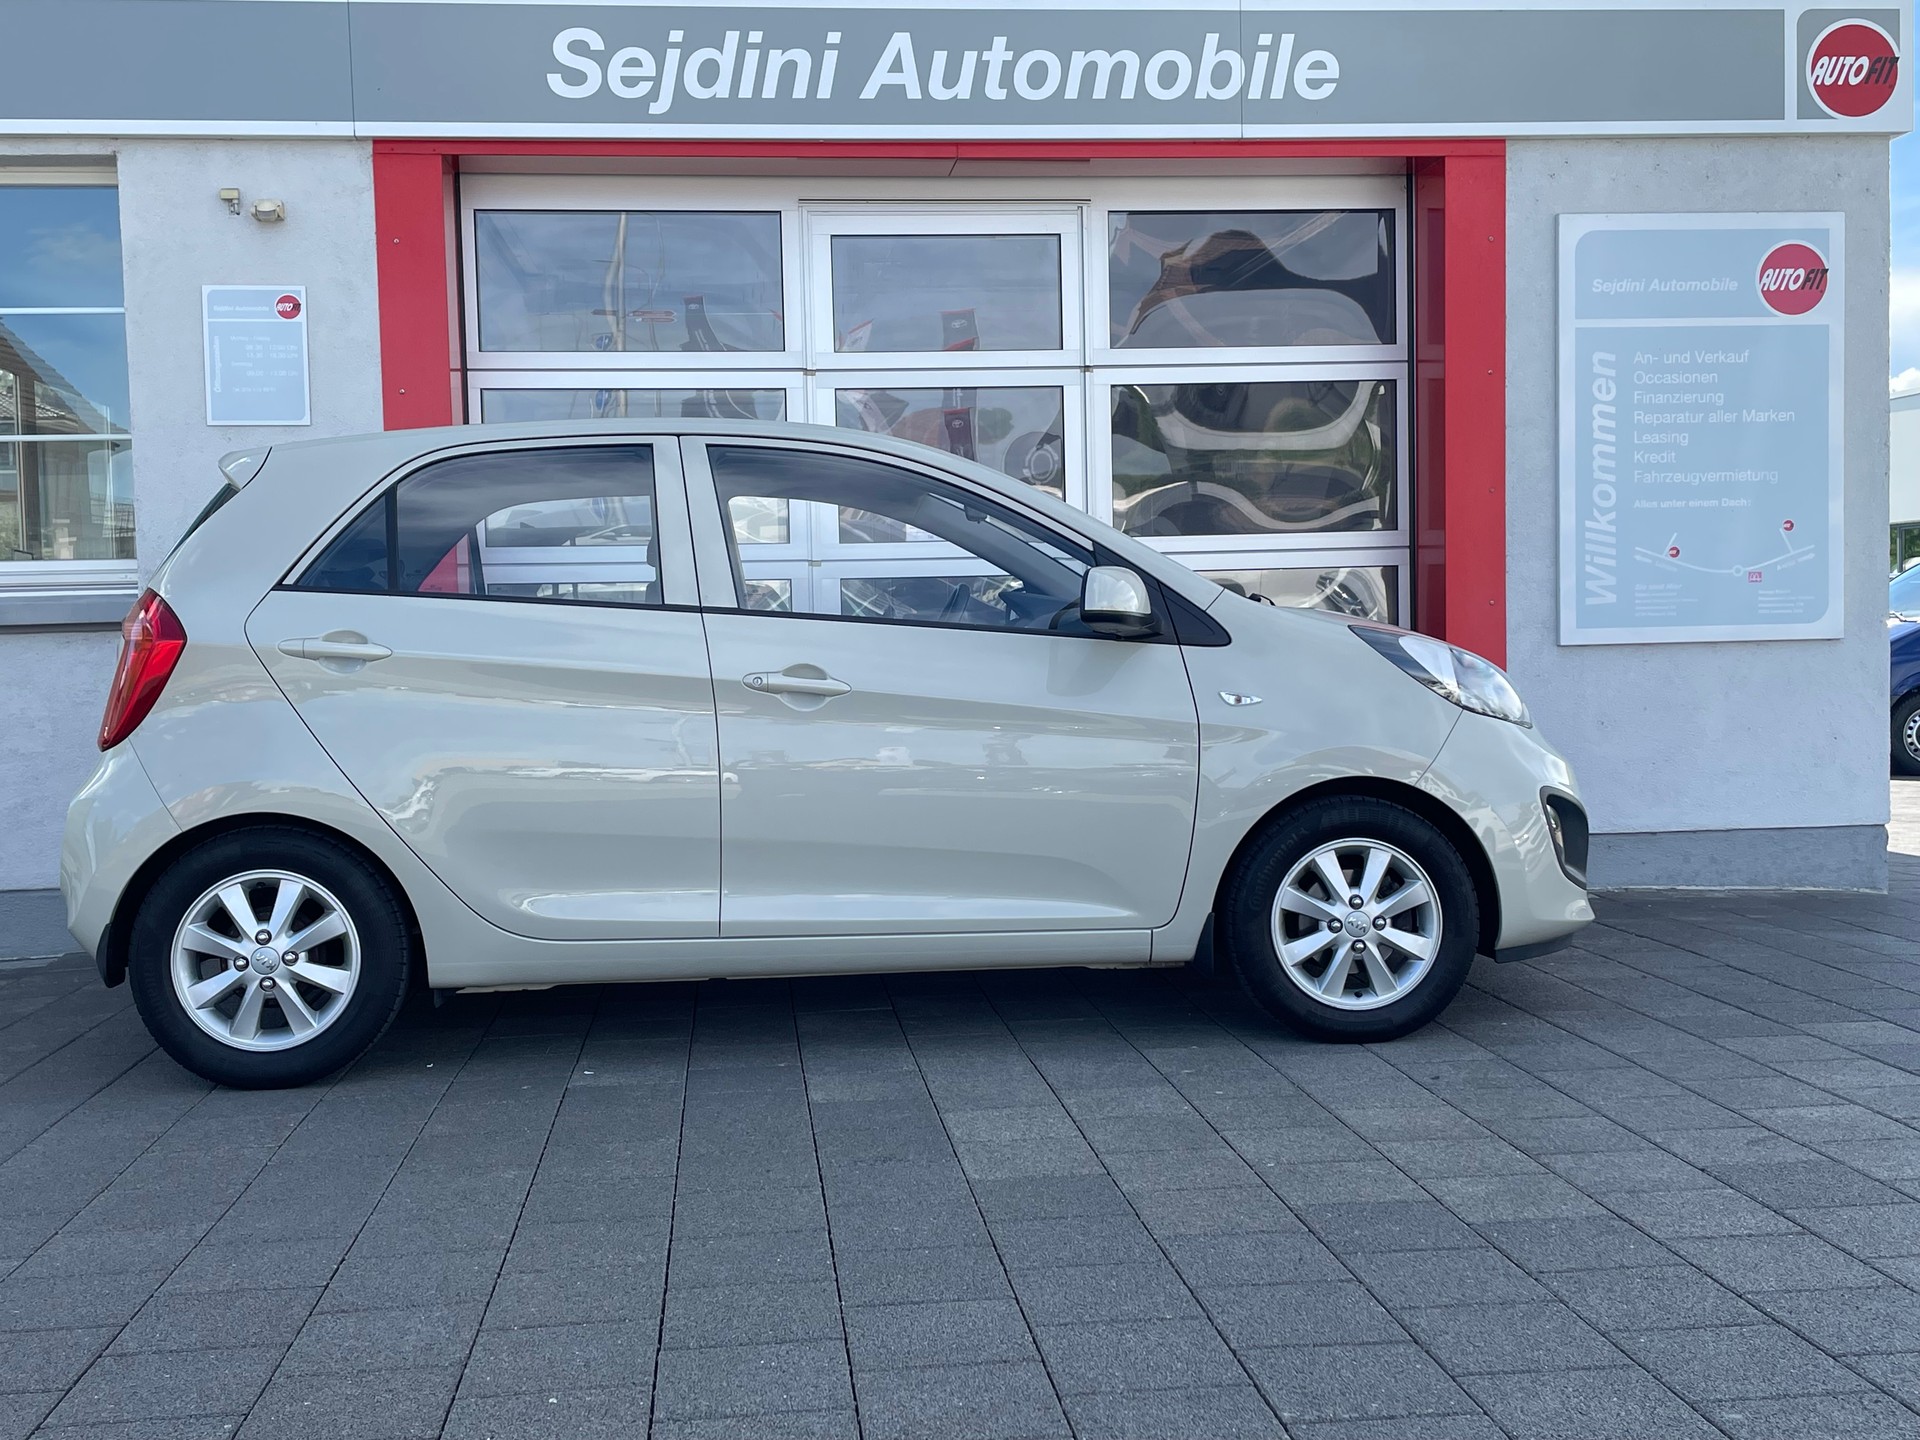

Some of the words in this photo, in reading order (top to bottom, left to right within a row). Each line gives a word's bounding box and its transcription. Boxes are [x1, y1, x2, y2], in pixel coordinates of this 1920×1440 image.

[546, 27, 843, 115] Sejdini
[859, 31, 1341, 102] Automobile
[1592, 278, 1645, 295] Sejdini
[1648, 277, 1739, 293] Automobile
[1633, 351, 1659, 365] An-
[1664, 351, 1690, 364] und
[1694, 349, 1750, 364] Verkauf
[1633, 370, 1719, 384] Occasionen
[1633, 390, 1725, 406] Finanzierung
[1633, 410, 1705, 427] Reparatur
[1708, 409, 1739, 423] aller
[1742, 408, 1796, 423] Marken
[1633, 431, 1690, 447] Leasing
[1633, 450, 1677, 464] Kredit
[1585, 351, 1617, 605] Willkommen
[1633, 469, 1780, 486] Fahrzeugvermietung
[1660, 499, 1687, 508] unter
[1688, 498, 1719, 508] einem
